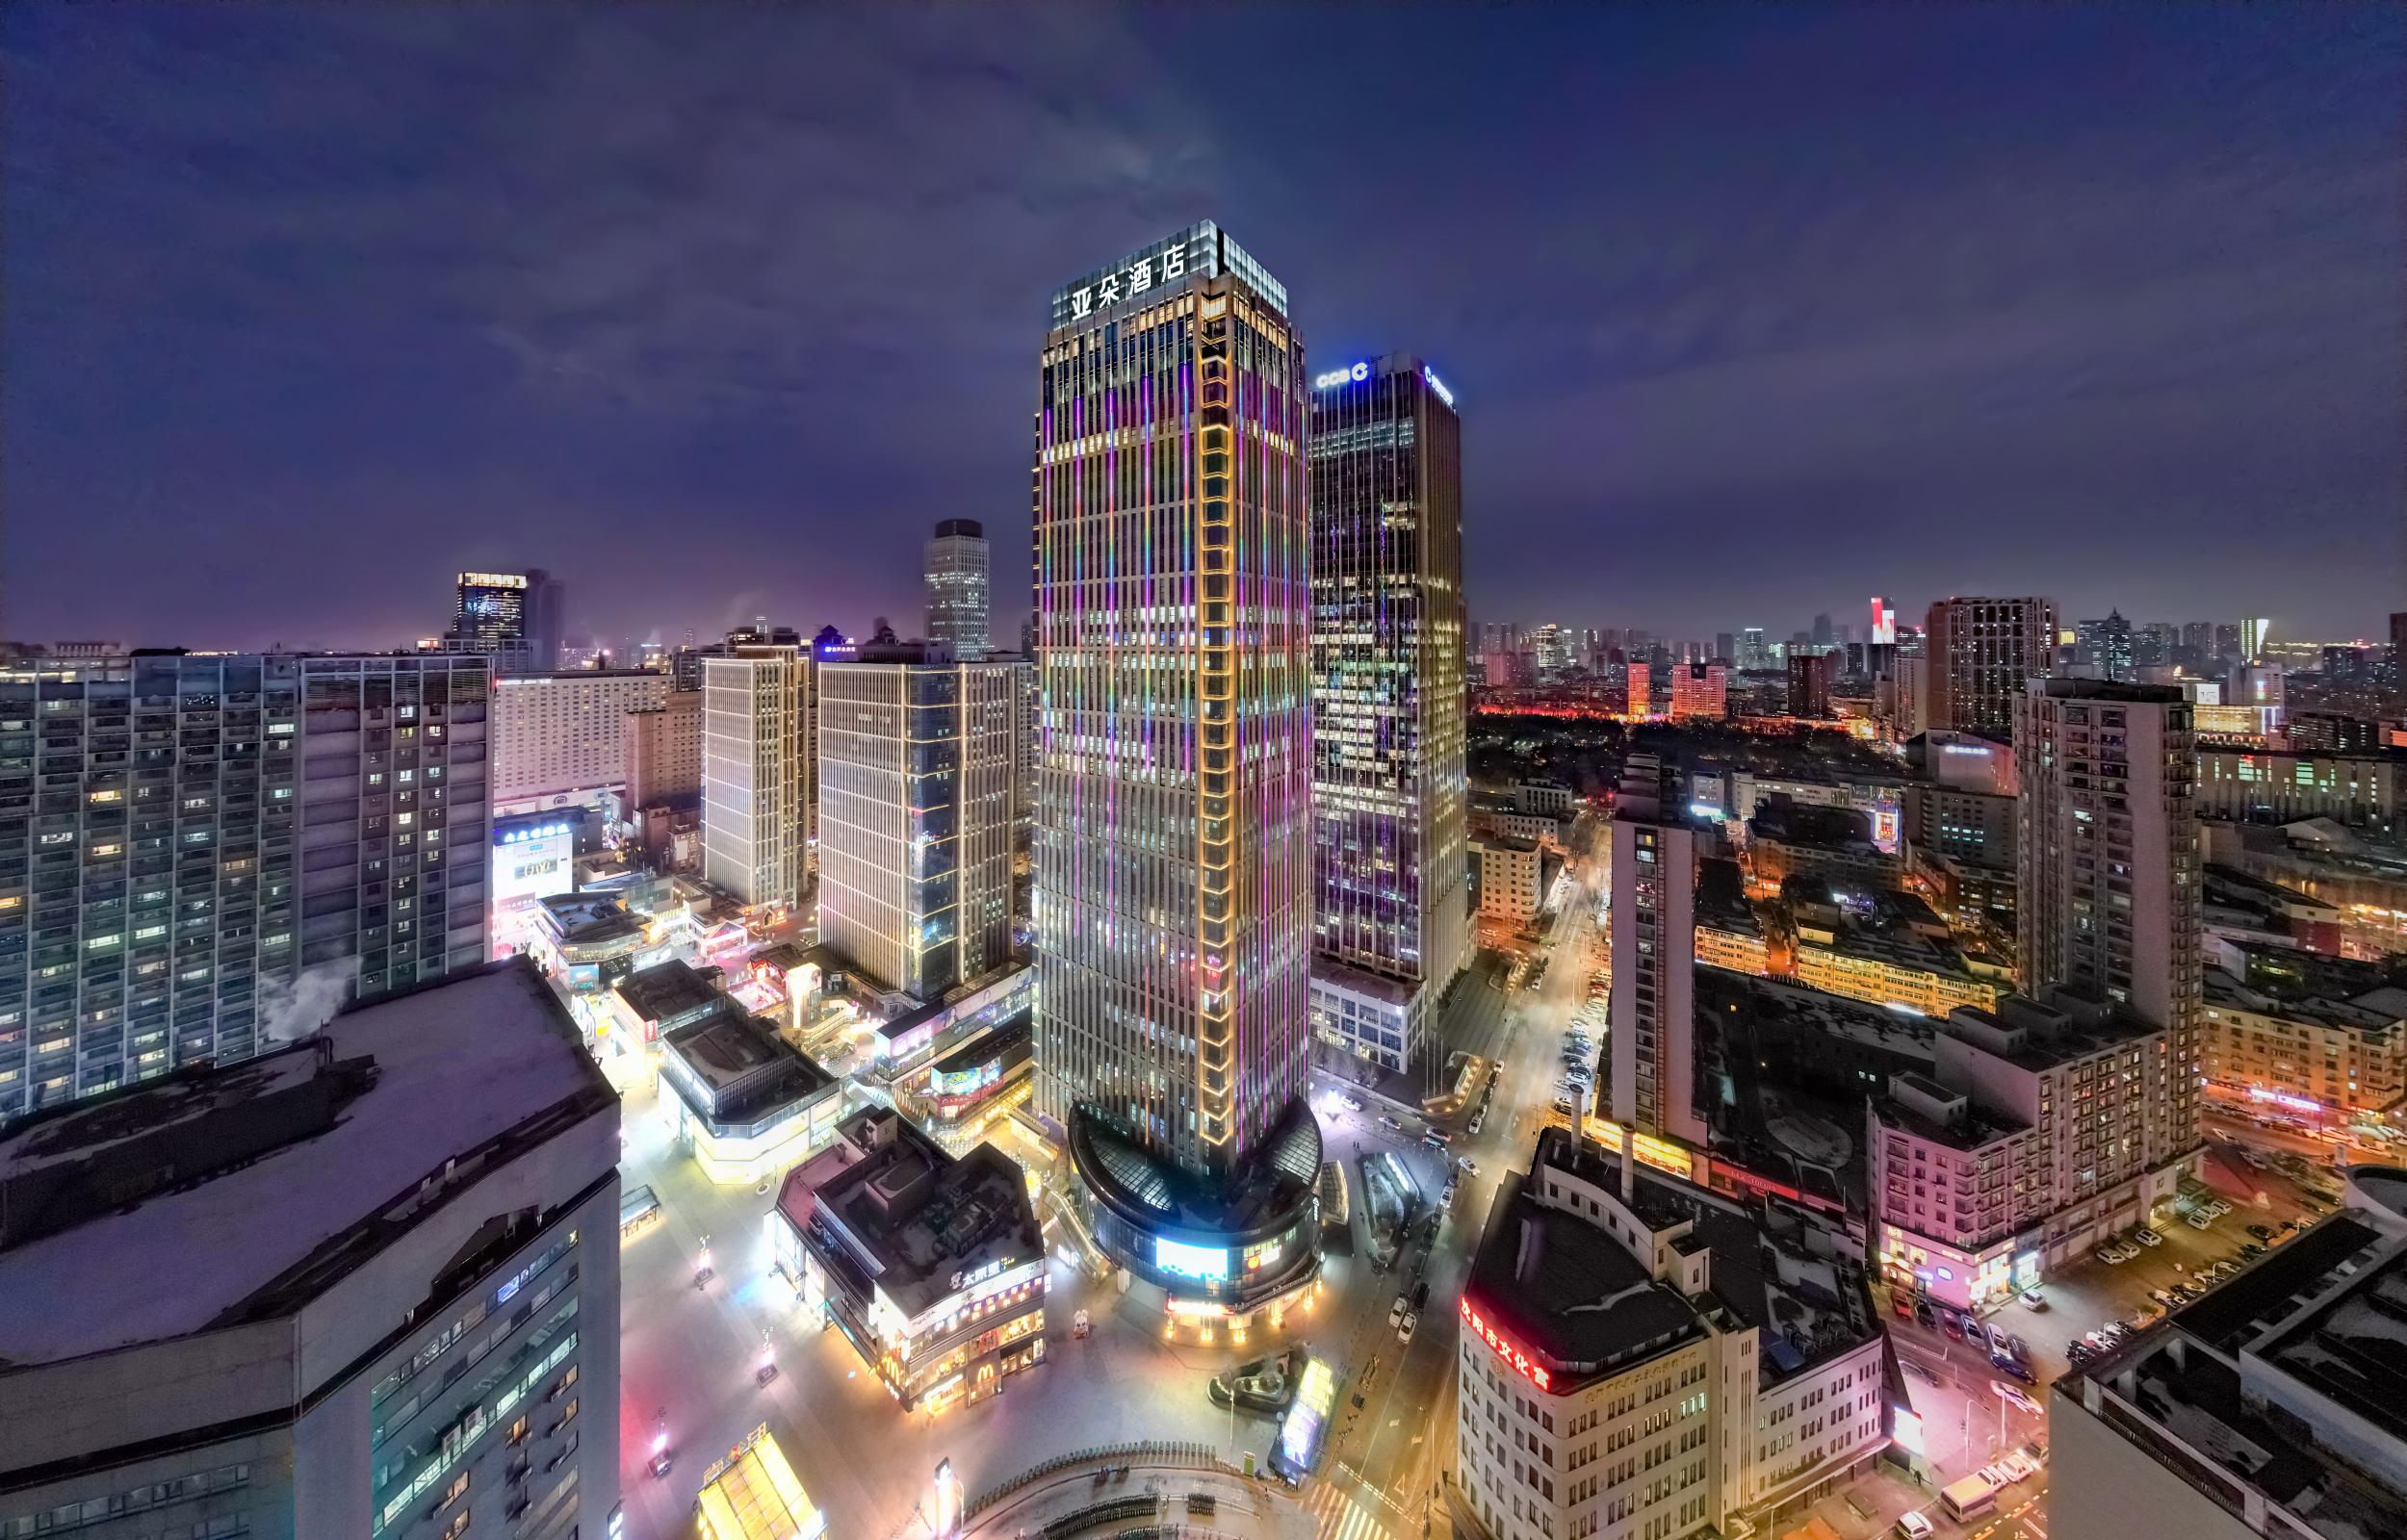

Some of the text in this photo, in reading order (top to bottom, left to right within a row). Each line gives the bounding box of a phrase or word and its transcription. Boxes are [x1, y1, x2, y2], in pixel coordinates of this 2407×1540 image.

[1072, 244, 1185, 321] 亚朵酒店
[1316, 369, 1351, 388] CCB
[962, 1260, 1000, 1289] 太原里
[1461, 1296, 1550, 1390] 沈阳市文化宫
